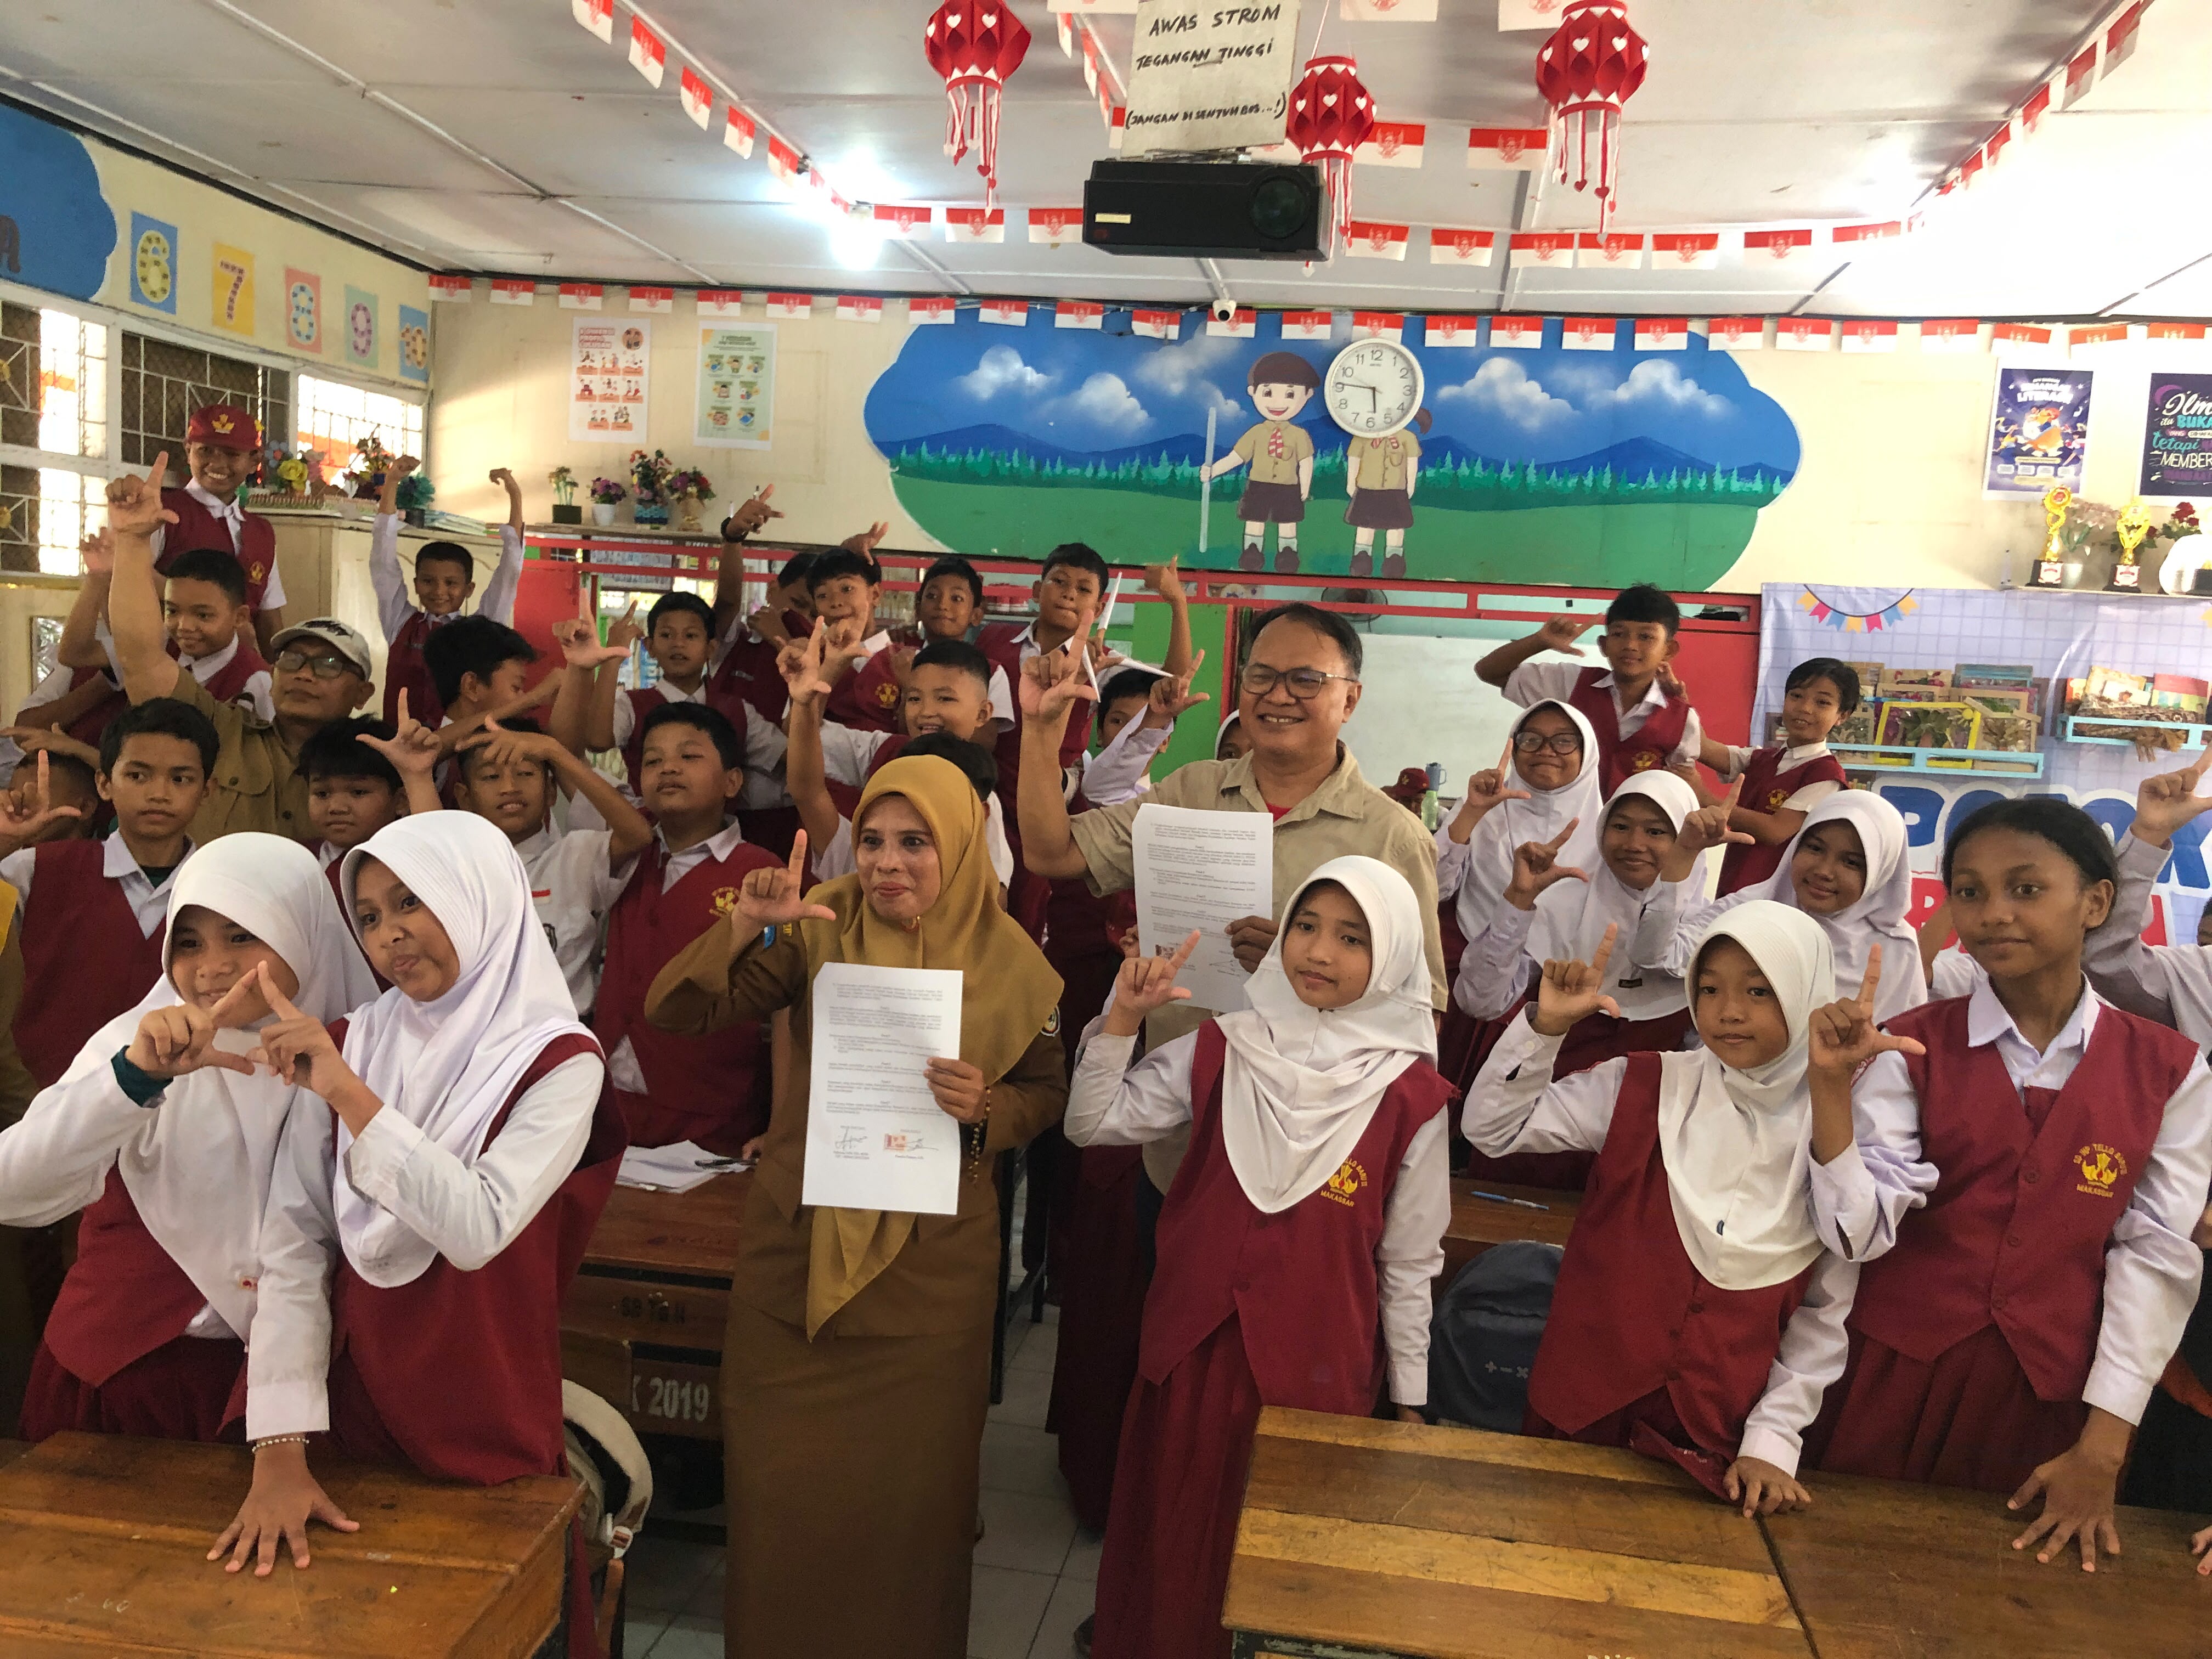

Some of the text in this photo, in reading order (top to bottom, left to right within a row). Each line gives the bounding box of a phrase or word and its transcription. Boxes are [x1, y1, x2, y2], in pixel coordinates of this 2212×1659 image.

[1149, 4, 1281, 37] AWAS STROM
[1136, 37, 1274, 71] TEGANGAN TINGGI
[1125, 110, 1178, 129] (JANGAN
[136, 230, 171, 303] 6
[219, 259, 245, 325] 7
[290, 282, 317, 345] 8
[351, 302, 373, 358] 9
[400, 323, 428, 369] 10
[1356, 354, 1364, 365] 11
[1371, 349, 1383, 362] 12
[1392, 356, 1397, 366] 1
[1342, 367, 1354, 378] 10
[1400, 368, 1408, 379] 2
[1335, 382, 1344, 392] 9
[1403, 385, 1412, 396] 3
[1339, 399, 1348, 409] 8
[1397, 402, 1404, 411] 4
[1351, 413, 1360, 423] 7
[1366, 417, 1375, 428] 6
[1384, 413, 1392, 424] 5
[2152, 430, 2200, 453] tetapi
[2160, 452, 2212, 469] MEMBER
[1320, 1190, 1355, 1207] MAKASSAR
[648, 1376, 710, 1423] 2019
